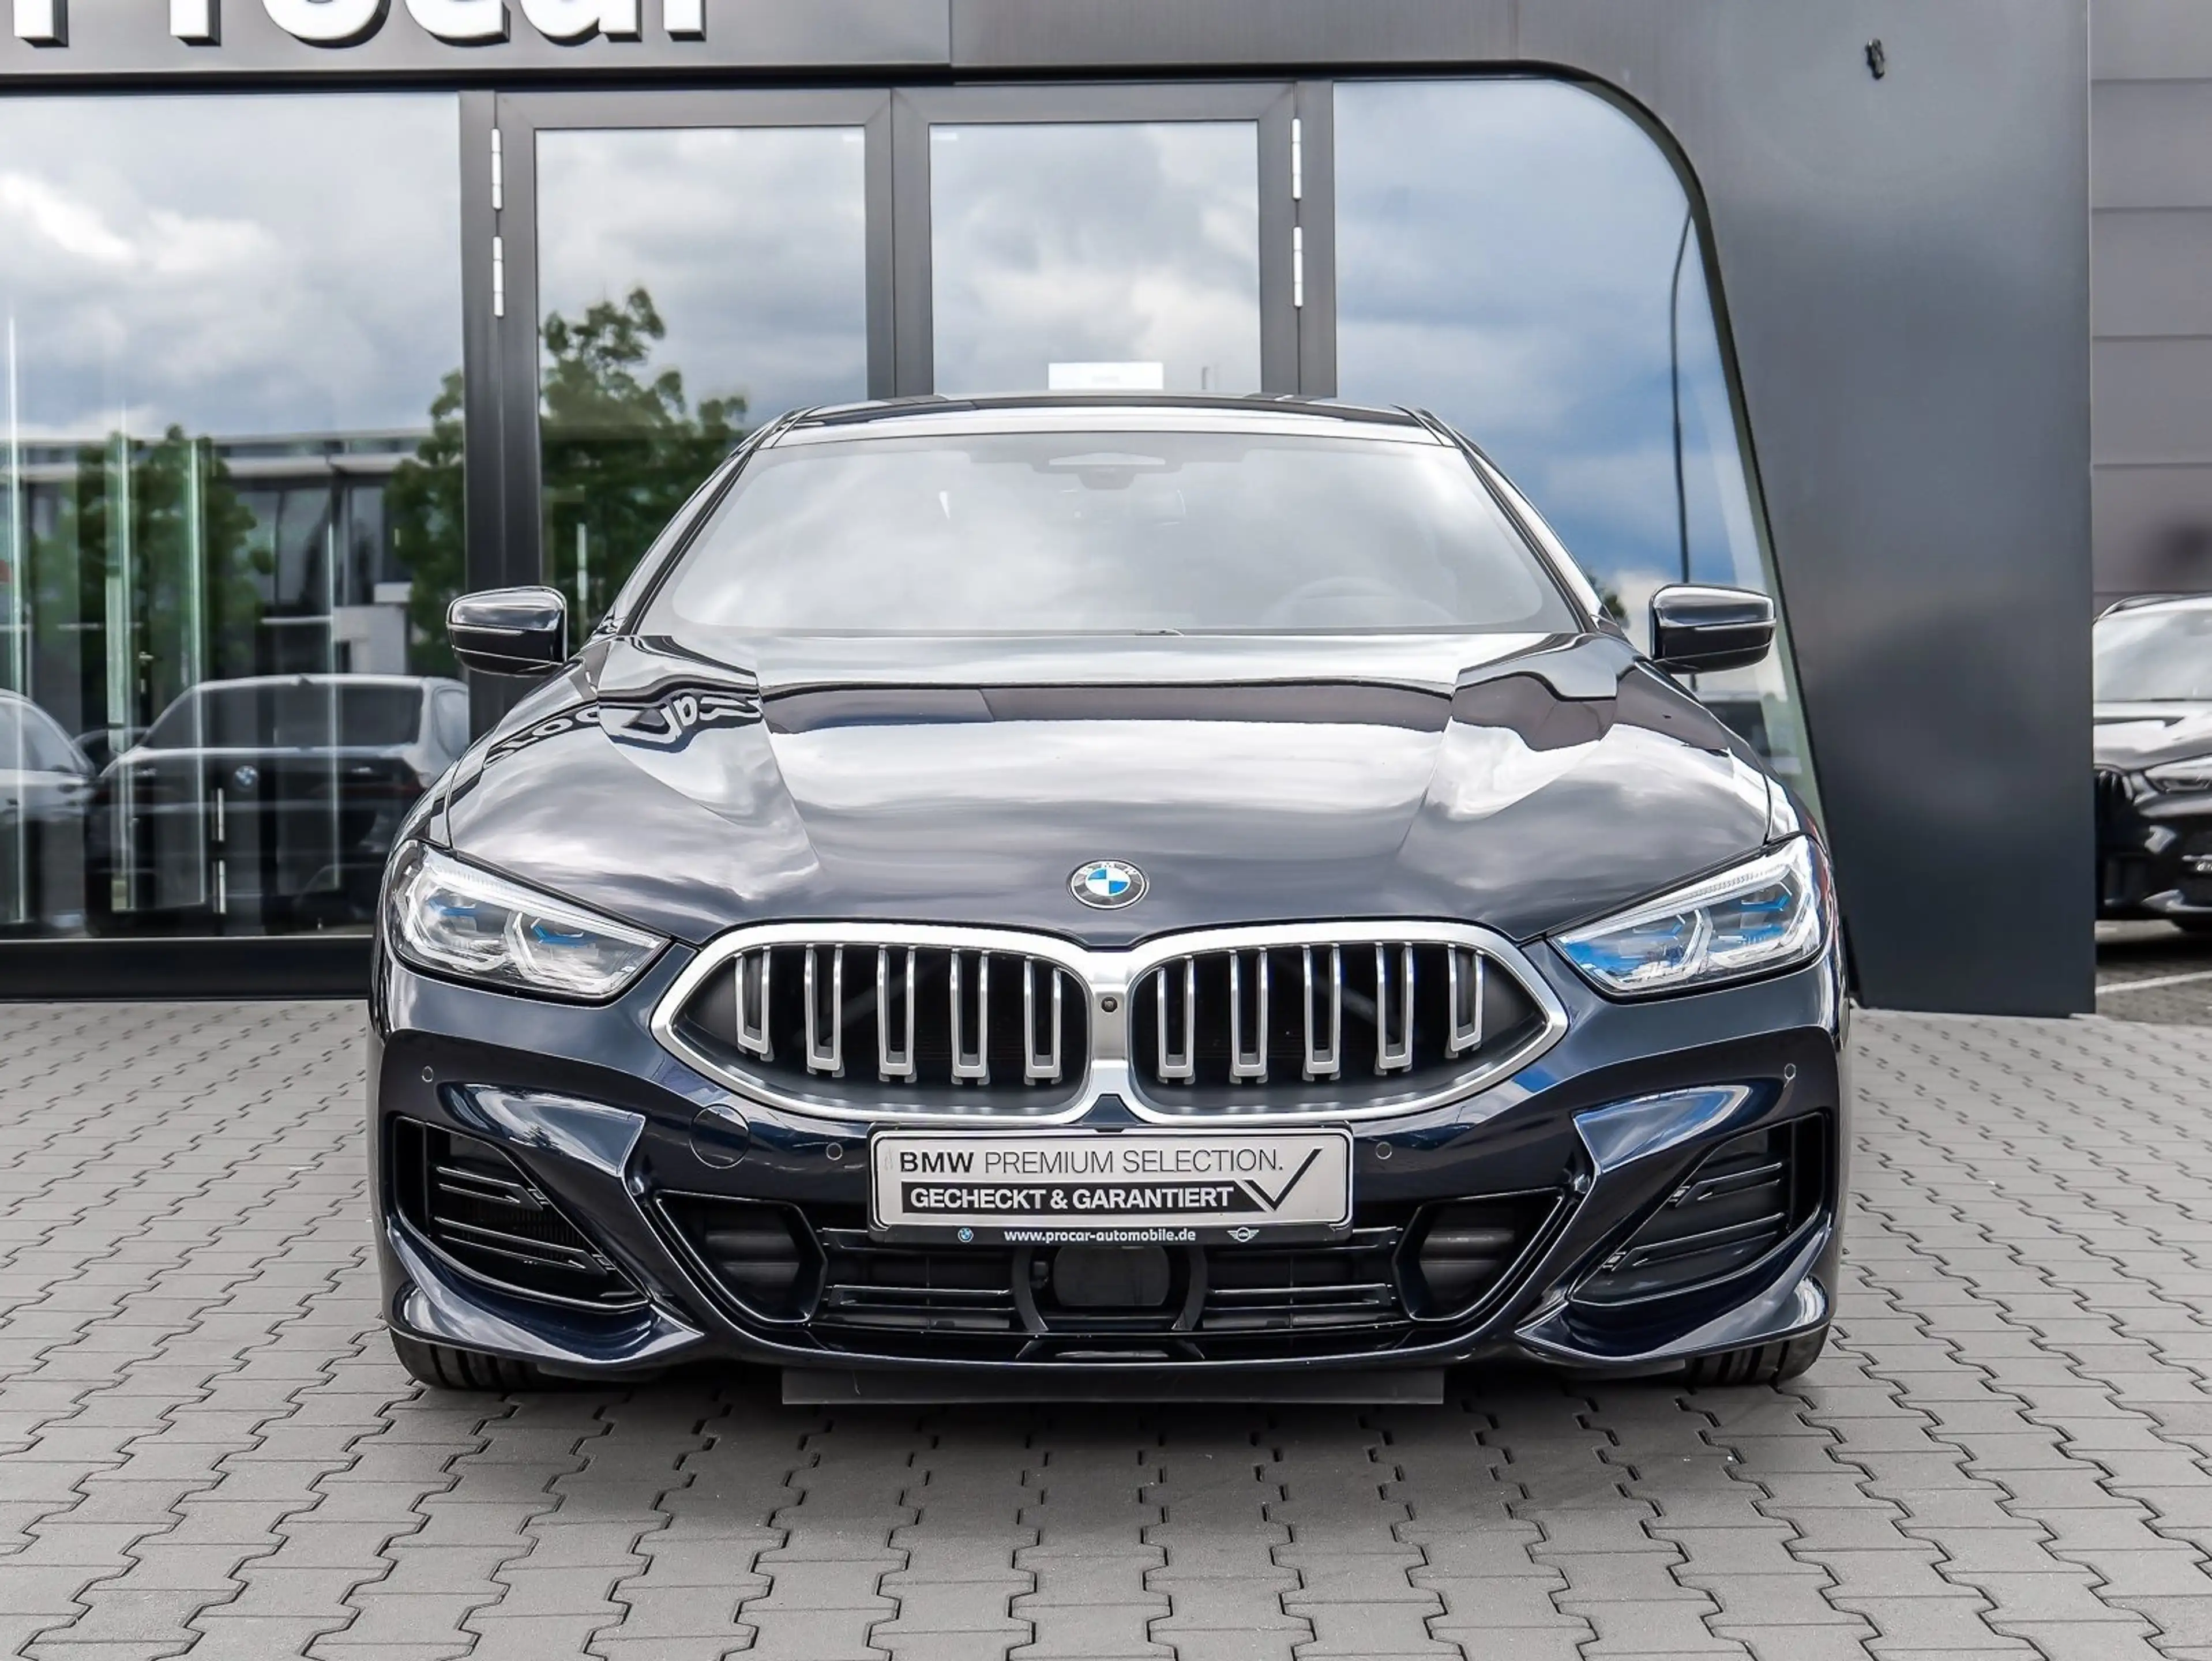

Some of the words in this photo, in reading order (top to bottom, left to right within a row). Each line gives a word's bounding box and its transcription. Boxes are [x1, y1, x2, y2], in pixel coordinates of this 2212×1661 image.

[900, 1151, 974, 1173] BMW
[985, 1151, 1114, 1174] PREMIUM
[1122, 1148, 1283, 1173] SELECTION.
[910, 1187, 1046, 1209] GECHECKT
[1050, 1189, 1068, 1209] &
[1072, 1186, 1234, 1209] GARANTIERT
[1003, 1227, 1196, 1244] www.procar-automobile.de
